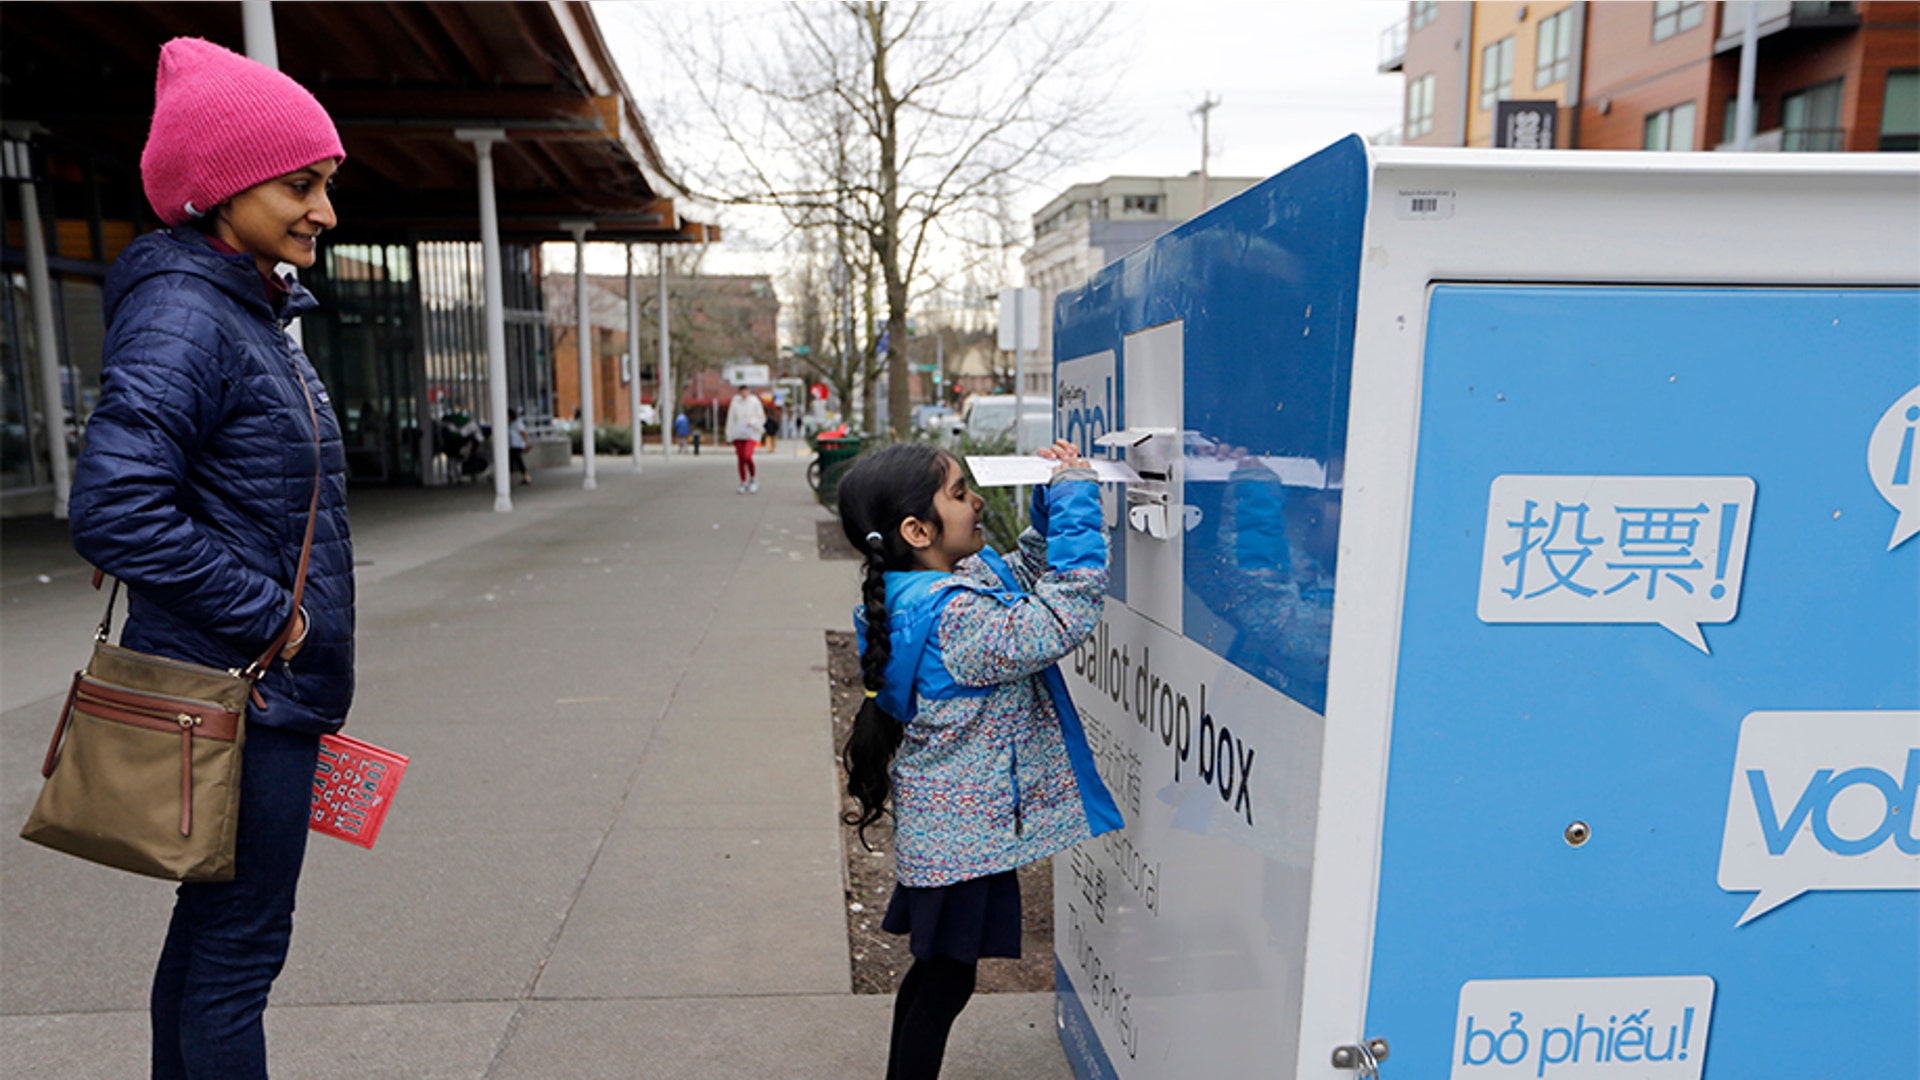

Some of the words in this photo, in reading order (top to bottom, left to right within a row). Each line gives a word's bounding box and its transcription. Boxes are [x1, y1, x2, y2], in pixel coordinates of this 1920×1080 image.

[1500, 499, 1740, 600] 投票!
[1136, 646, 1191, 783] drop
[1199, 683, 1254, 827] box
[309, 743, 338, 817] JOK
[314, 752, 350, 821] LOUD
[333, 759, 369, 828] LAUGH
[342, 761, 386, 835] COMPLETE
[1462, 1011, 1529, 1066] bỏ
[1537, 1007, 1695, 1078] phiếu!
